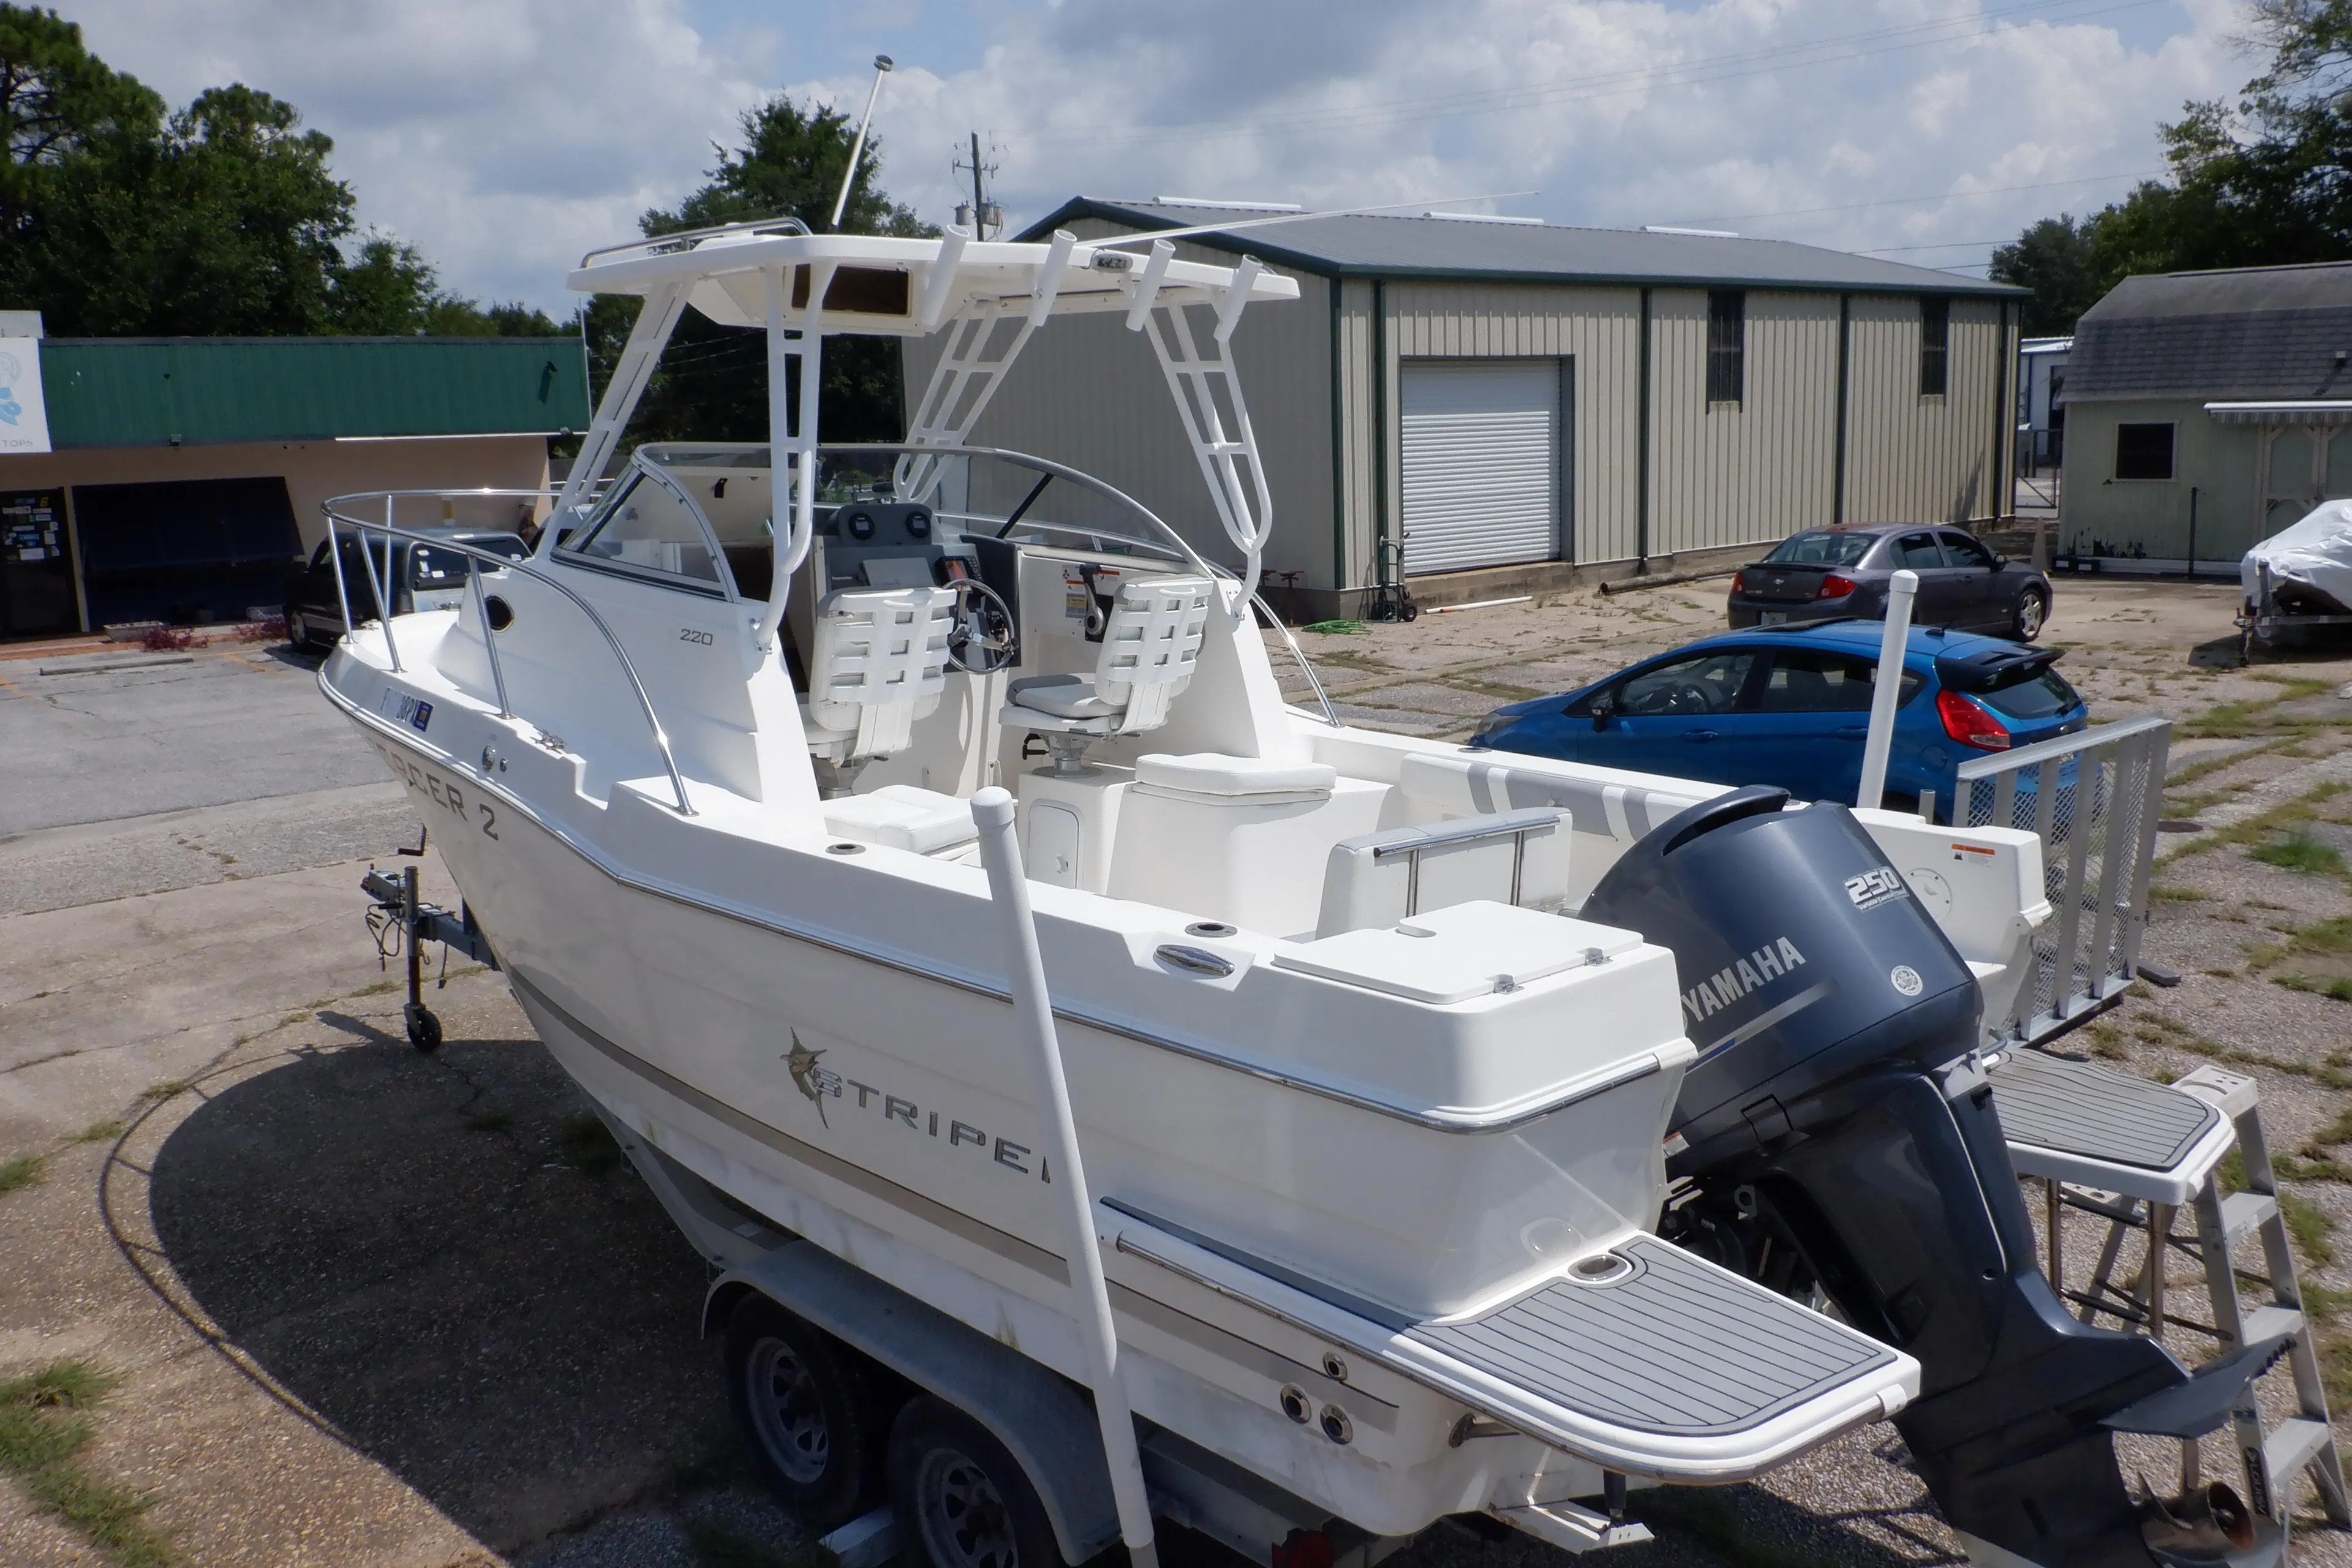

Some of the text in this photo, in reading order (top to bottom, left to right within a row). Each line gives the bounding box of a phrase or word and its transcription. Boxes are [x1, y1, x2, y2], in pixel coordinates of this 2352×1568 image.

[680, 628, 713, 646] 220
[480, 803, 498, 841] 2
[1845, 869, 1900, 904] 250
[1681, 936, 1806, 1022] YAMAHA
[813, 1067, 1050, 1183] STRIPE
